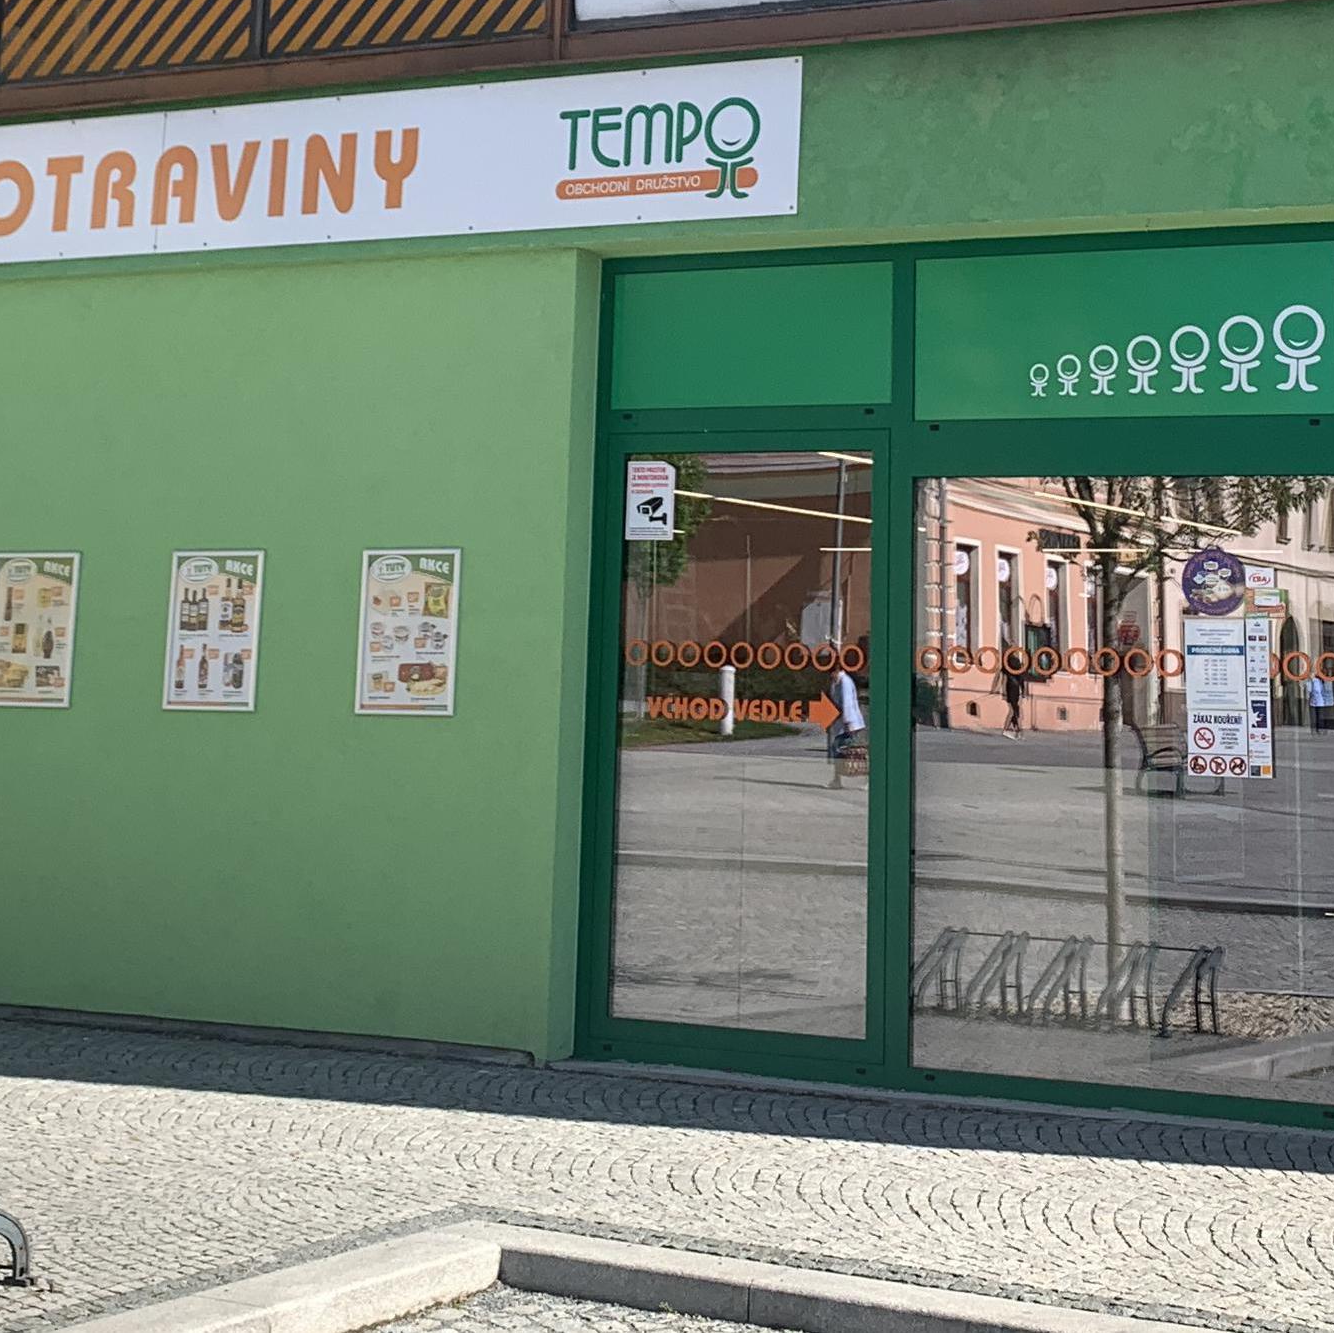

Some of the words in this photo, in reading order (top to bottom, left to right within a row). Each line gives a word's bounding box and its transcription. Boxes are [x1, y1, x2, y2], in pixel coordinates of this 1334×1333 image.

[559, 97, 761, 171] TEMPO
[565, 176, 631, 196] OBCHODNÍ
[635, 173, 701, 192] DRUŽSTVO
[646, 696, 726, 721] VCHOD
[734, 698, 803, 723] VEDLE
